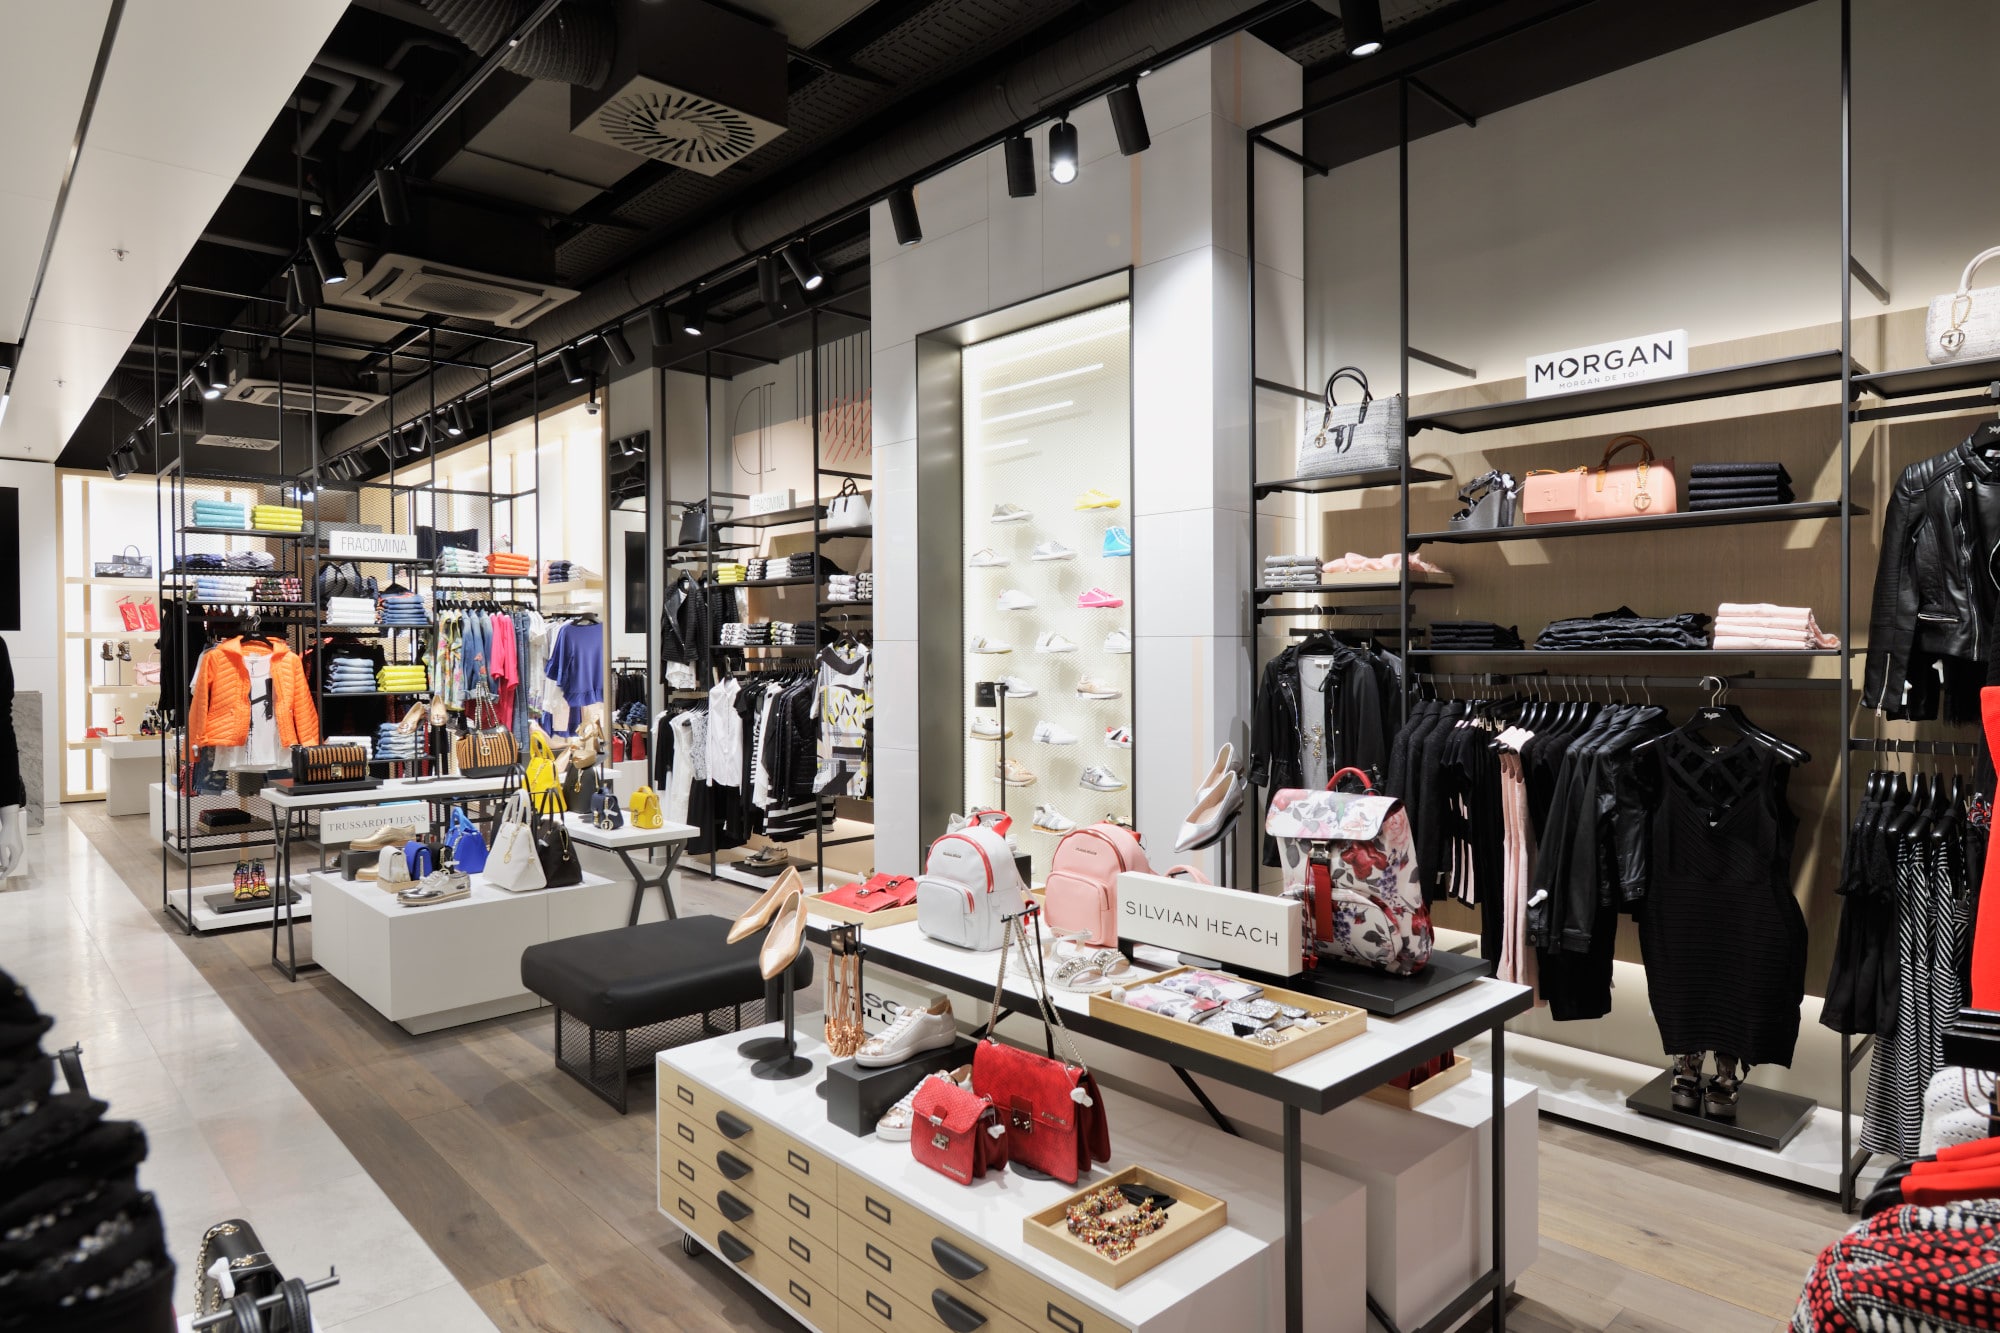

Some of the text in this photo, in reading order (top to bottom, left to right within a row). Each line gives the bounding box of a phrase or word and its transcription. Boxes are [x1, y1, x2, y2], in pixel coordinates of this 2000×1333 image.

[1535, 340, 1673, 383] MORGAN
[1559, 377, 1600, 389] MORGAN
[341, 536, 408, 553] FRACOMINA
[328, 818, 387, 832] TRUSSARDI
[1126, 901, 1278, 946] SILVIAN HEACH
